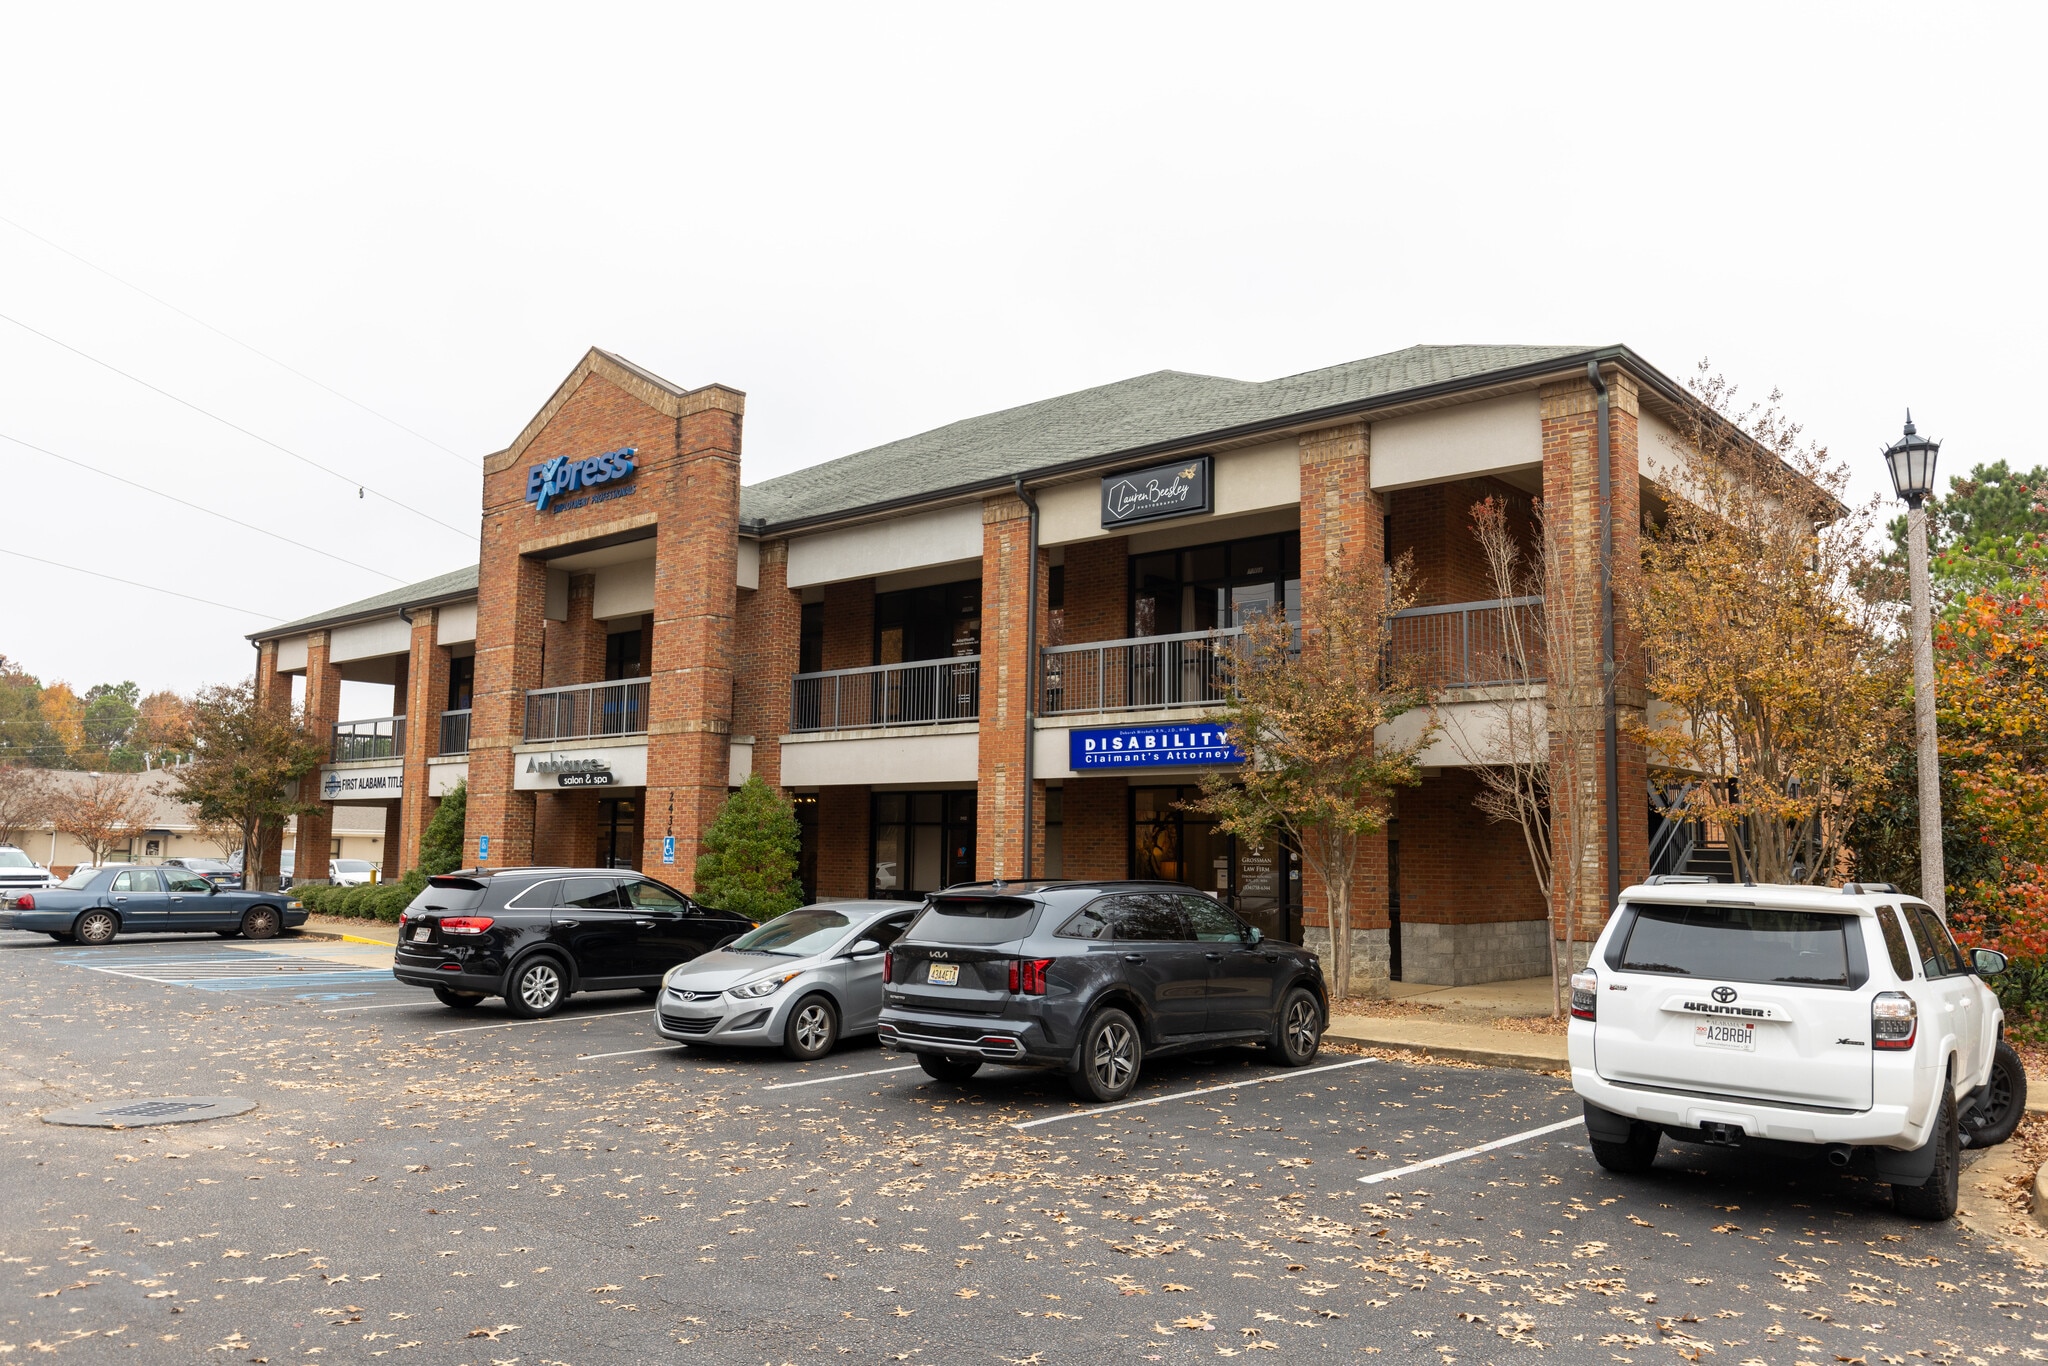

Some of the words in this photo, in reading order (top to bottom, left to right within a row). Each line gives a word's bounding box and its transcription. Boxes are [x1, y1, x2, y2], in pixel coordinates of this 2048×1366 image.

[1118, 485, 1148, 512] Lauren
[1146, 476, 1189, 503] Beesley
[1085, 732, 1228, 751] DISABILITY
[1085, 752, 1159, 763] Claimant's
[1167, 750, 1230, 760] Attorney
[342, 778, 358, 790] FIRST
[358, 776, 386, 789] ALABAMA
[388, 776, 402, 788] TITLE
[563, 775, 583, 785] salon
[585, 774, 591, 784] &
[594, 776, 607, 785] spa
[1684, 1002, 1764, 1017] 4RUNNER
[1707, 1026, 1752, 1043] A2BRBH
